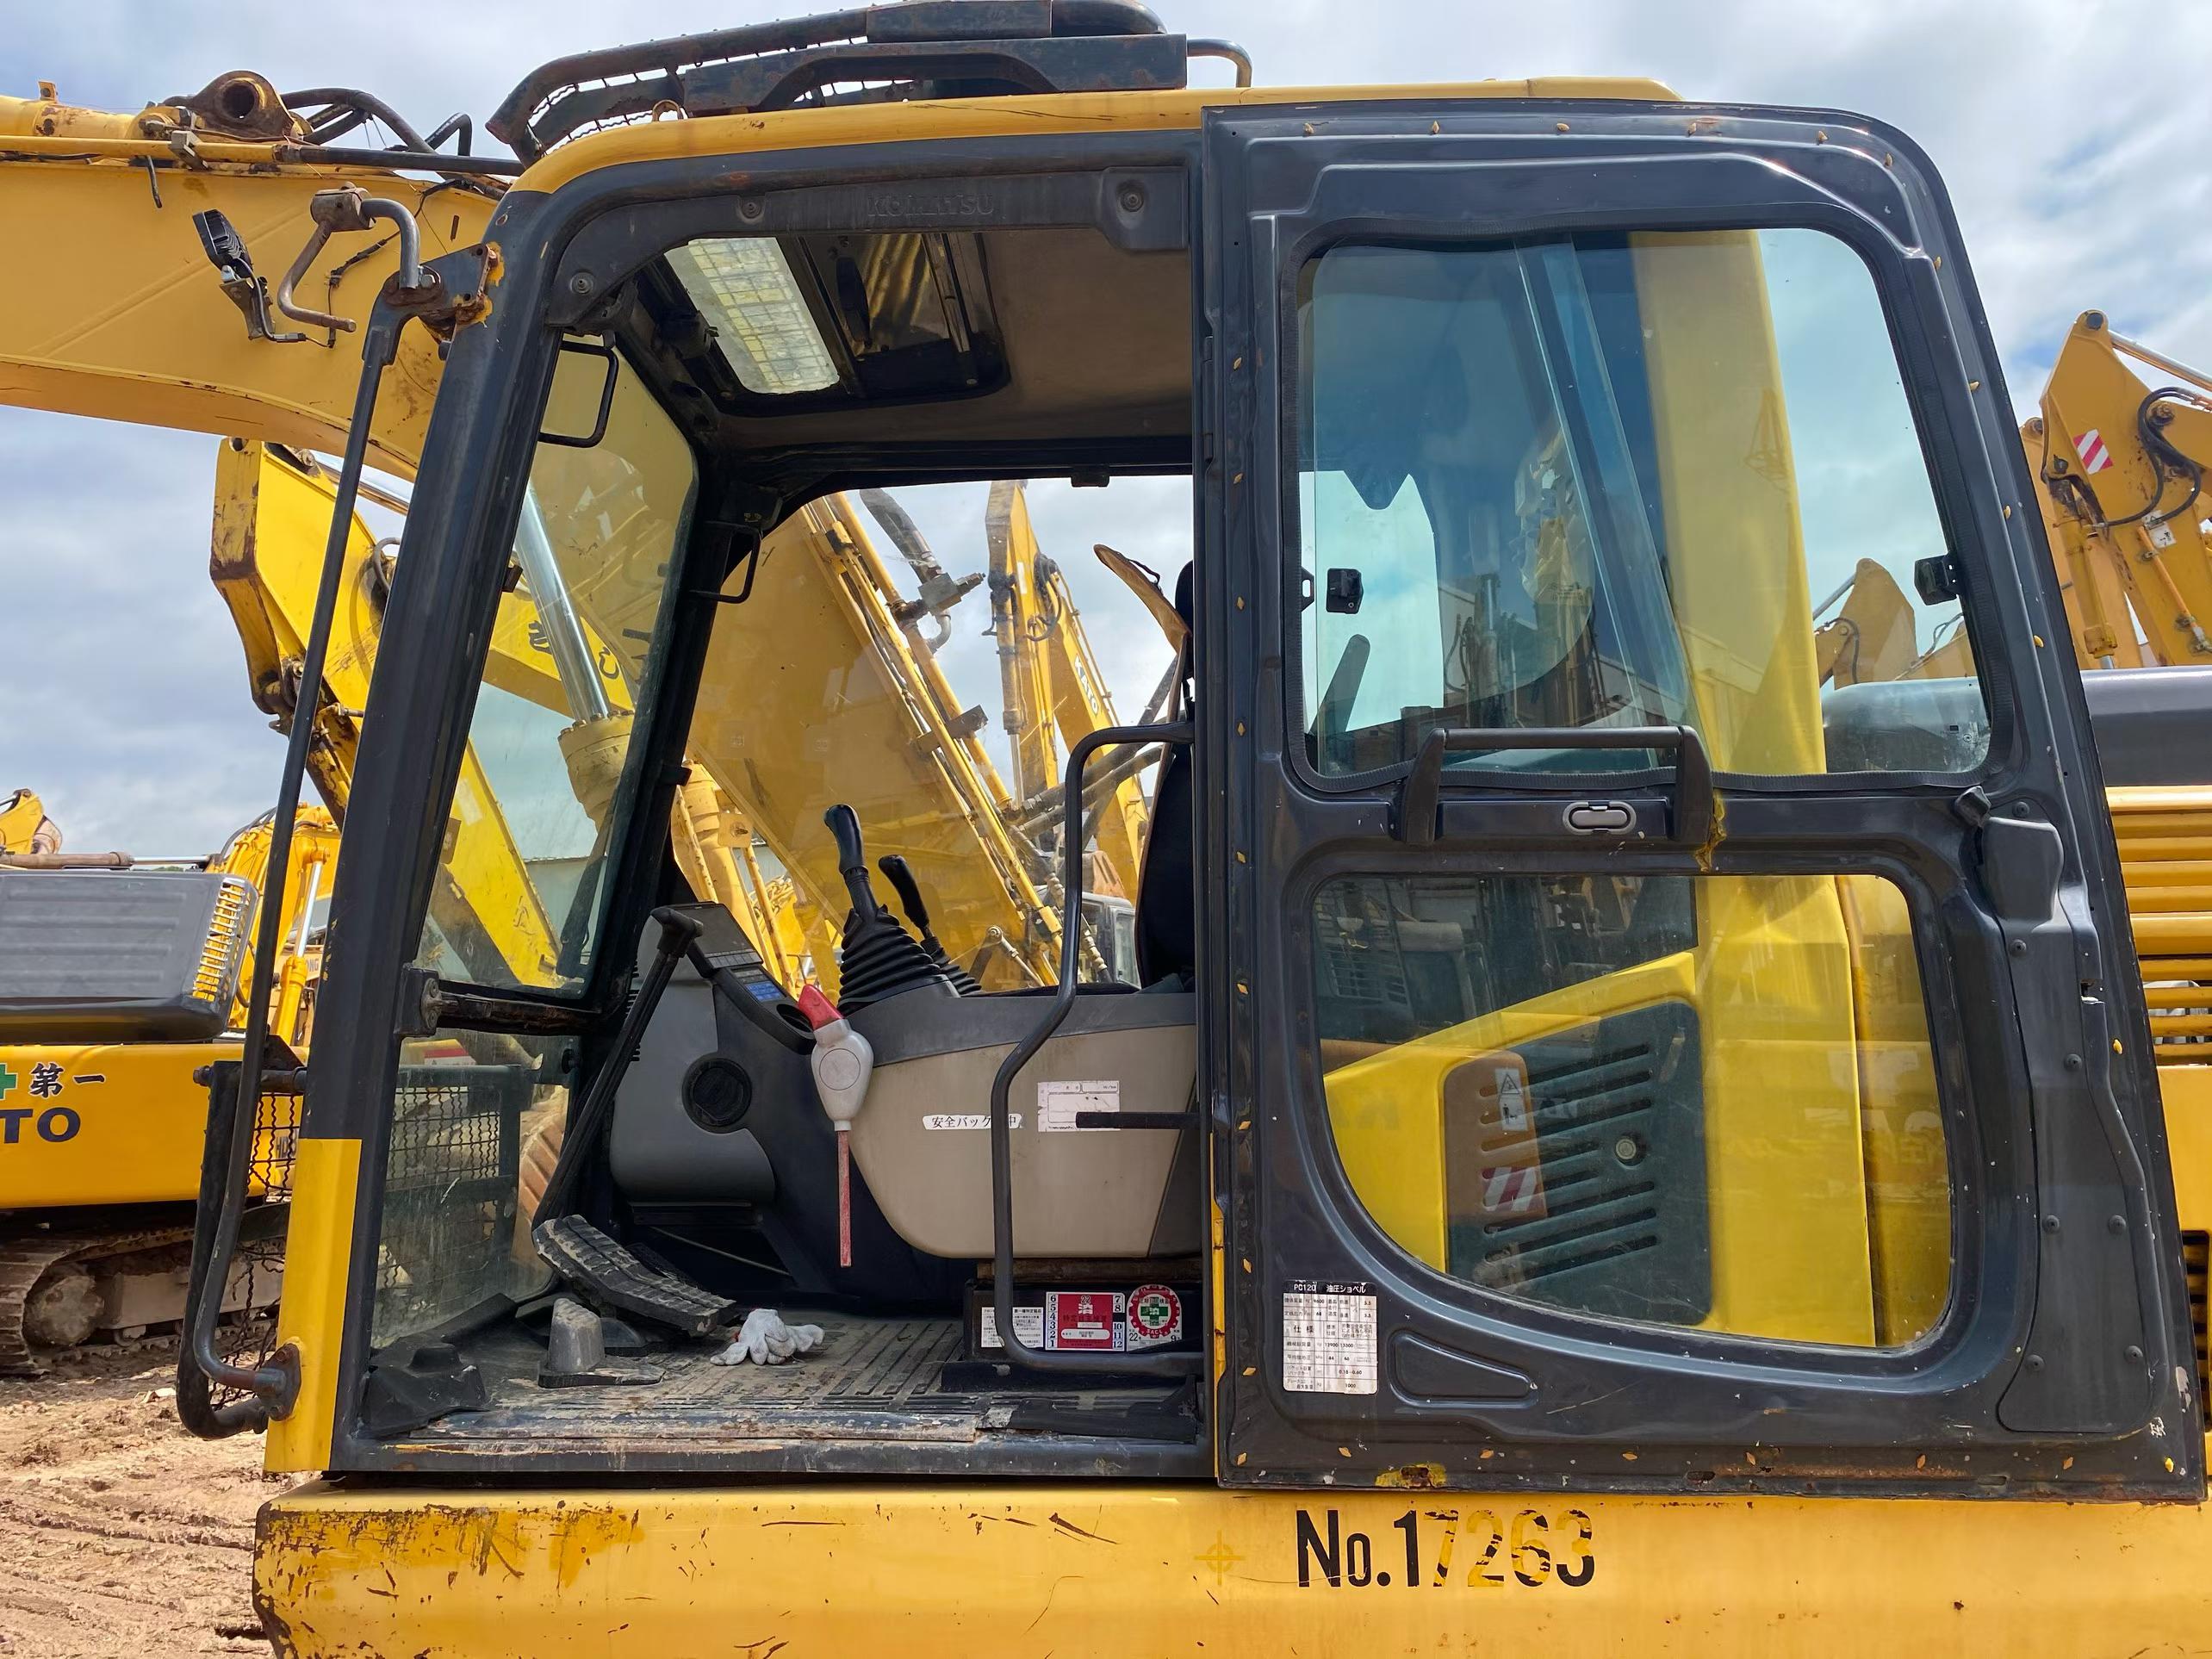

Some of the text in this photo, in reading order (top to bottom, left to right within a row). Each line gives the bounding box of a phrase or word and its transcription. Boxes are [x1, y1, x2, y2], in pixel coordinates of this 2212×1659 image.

[29, 1062, 105, 1097] 第一
[1327, 1284, 1366, 1294] 油圧ショベル
[1081, 1295, 1090, 1303] 22
[1128, 1333, 1138, 1342] 22
